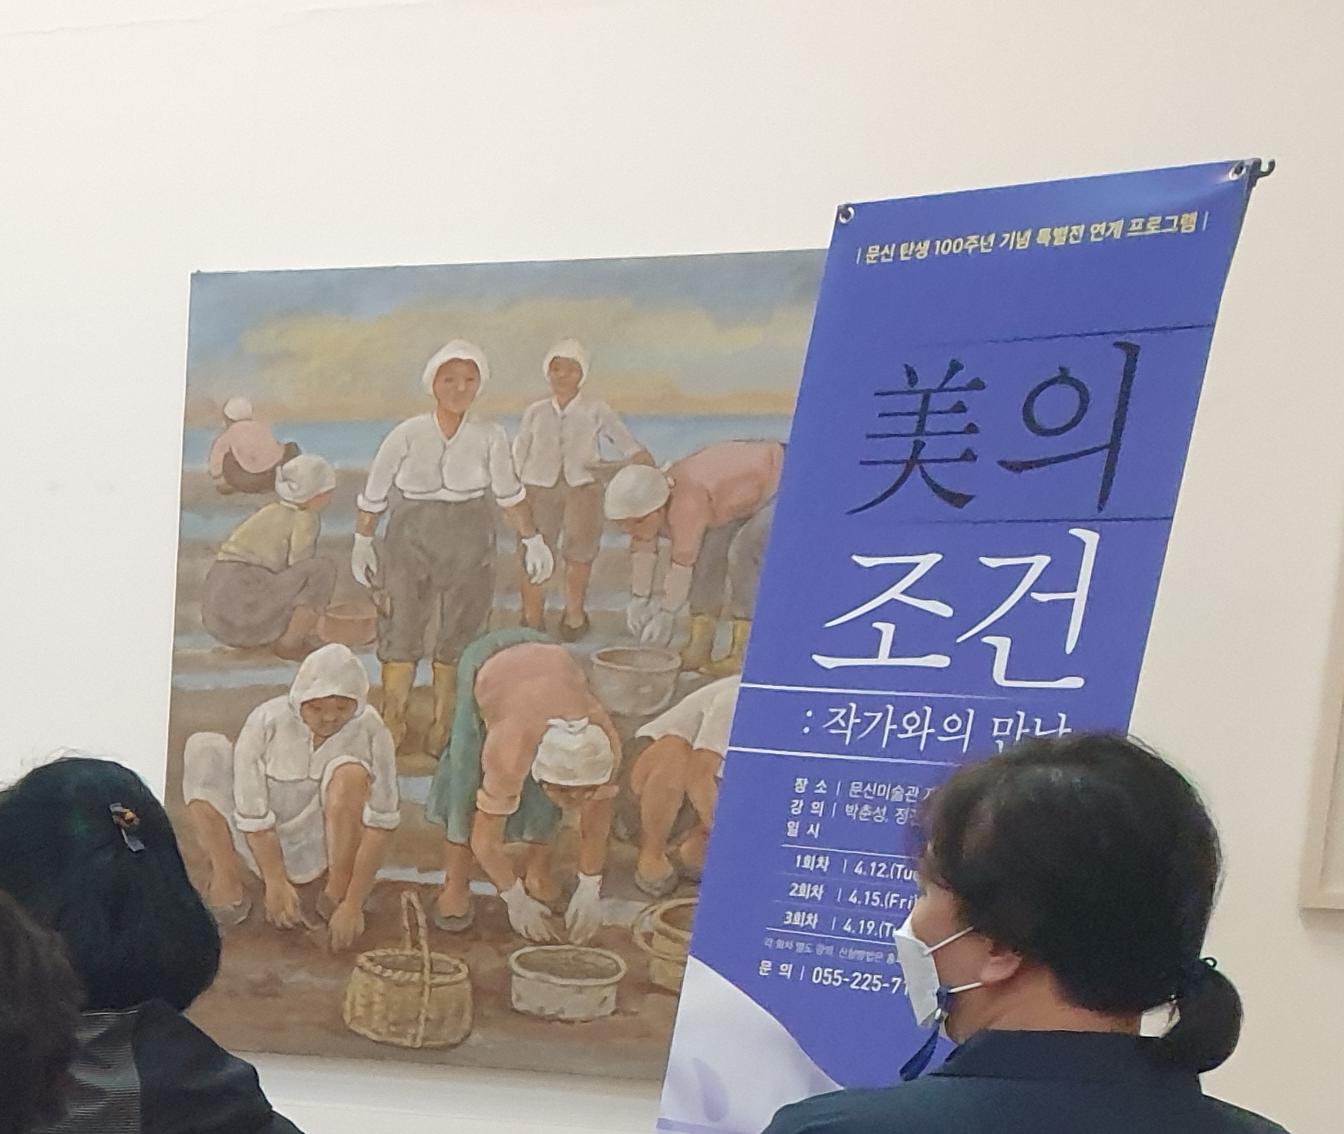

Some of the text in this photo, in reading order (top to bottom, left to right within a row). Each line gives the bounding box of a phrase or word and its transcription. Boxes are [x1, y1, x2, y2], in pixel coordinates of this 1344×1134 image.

[866, 211, 1198, 264] 문신 탄생 100주년 기념 특별전 연계 프로그램
[811, 527, 1099, 689] 조건
[823, 702, 975, 753] 작가와의
[848, 781, 920, 803] 문신미술관
[795, 854, 830, 872] 1회차
[788, 883, 824, 901] 2회차
[783, 910, 819, 929] 3회차
